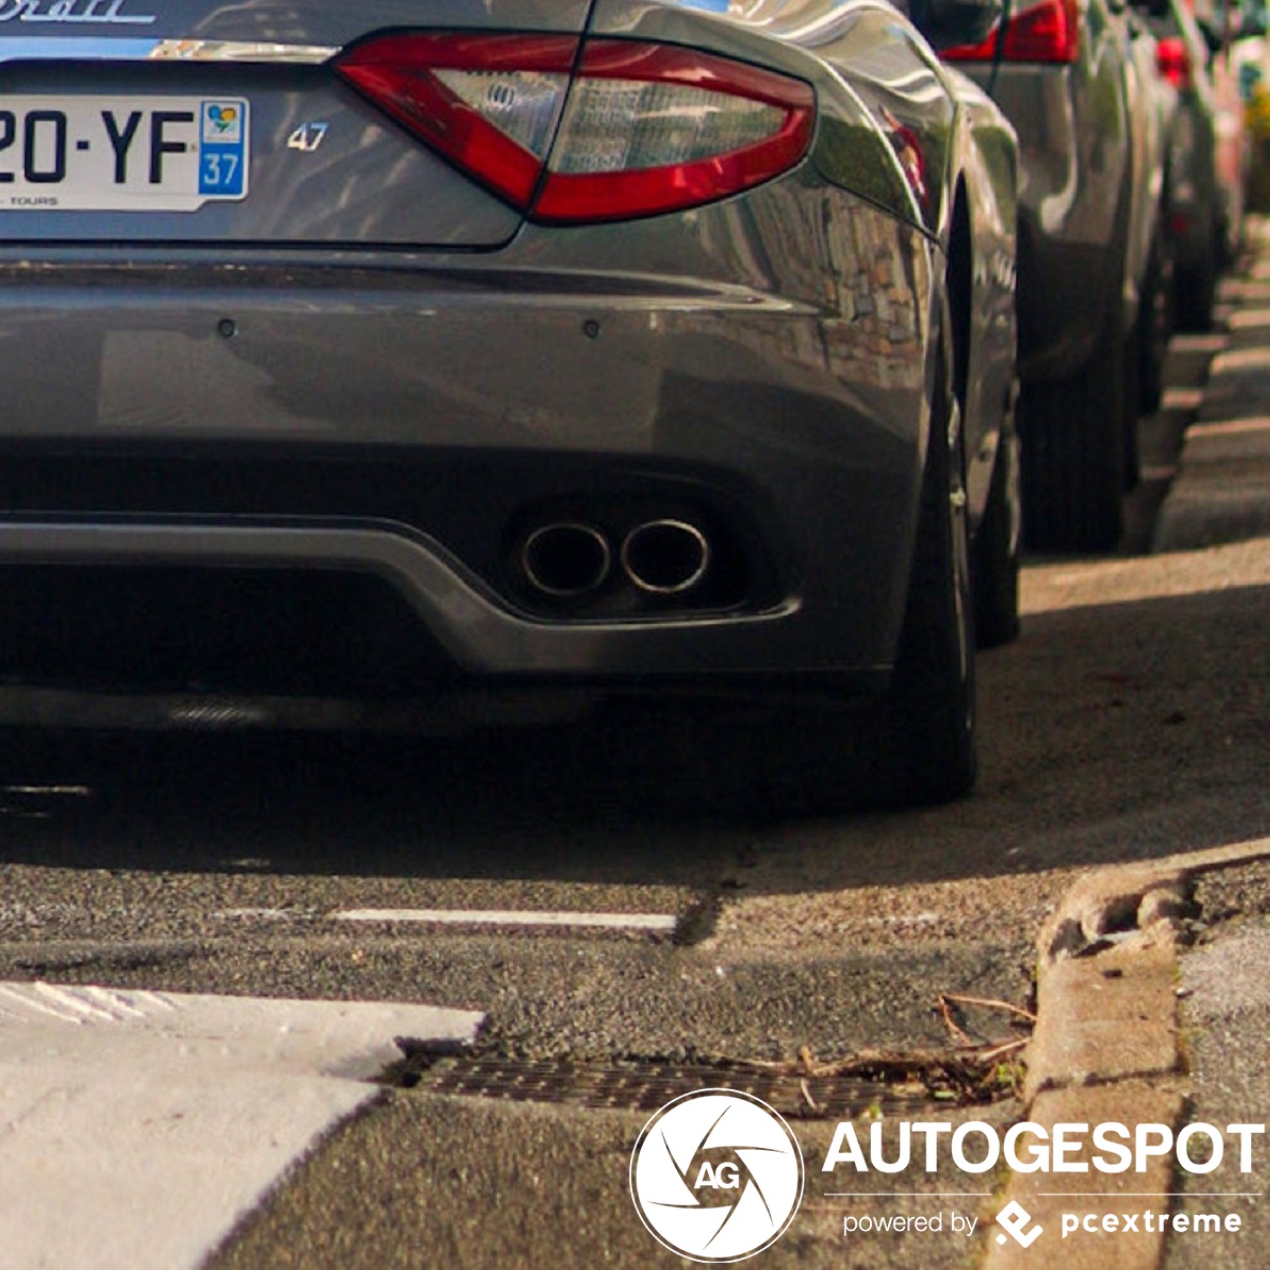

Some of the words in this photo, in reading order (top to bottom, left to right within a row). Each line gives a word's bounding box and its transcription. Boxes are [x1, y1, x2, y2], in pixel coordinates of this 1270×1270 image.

[288, 122, 328, 151] 47
[204, 153, 238, 184] 37
[10, 196, 59, 206] TOURS
